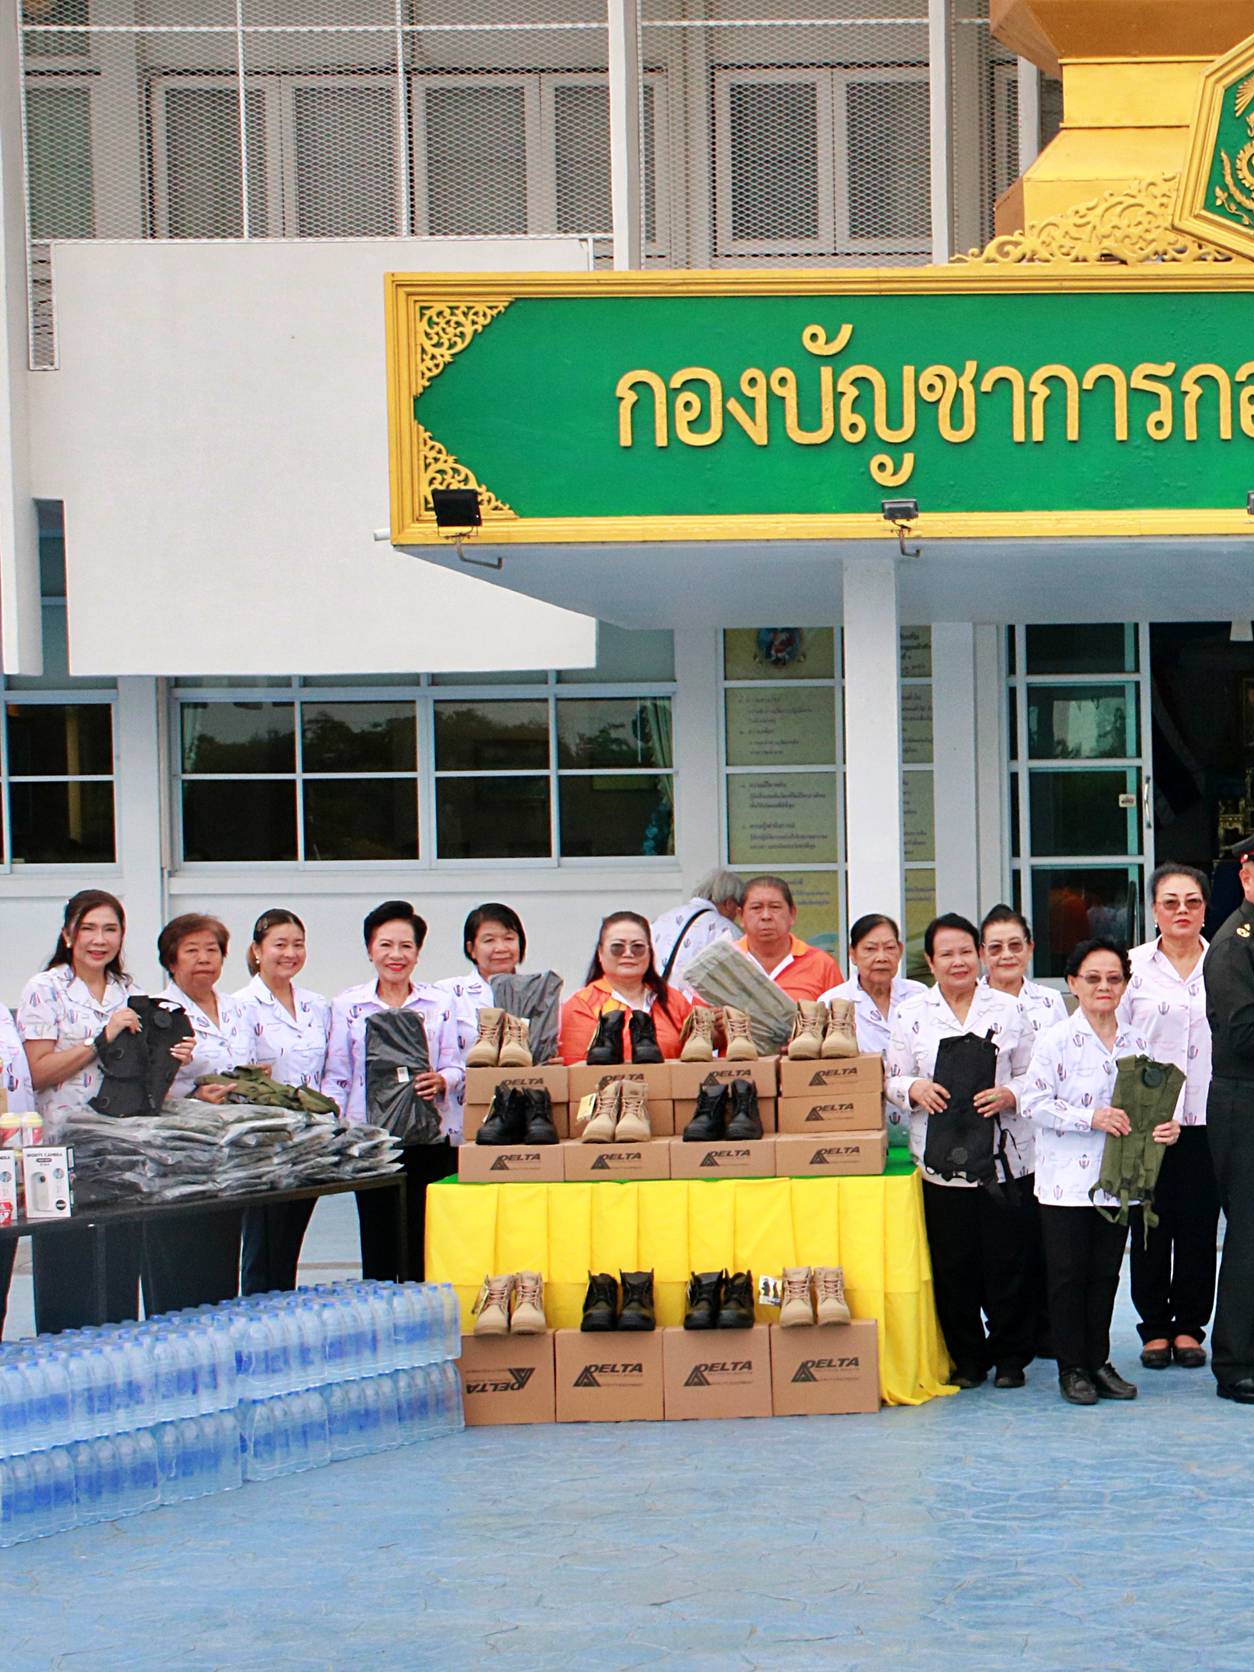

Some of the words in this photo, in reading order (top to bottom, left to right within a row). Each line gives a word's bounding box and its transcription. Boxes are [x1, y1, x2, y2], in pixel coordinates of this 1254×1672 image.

[711, 1068, 751, 1077] DELTA
[817, 1067, 858, 1077] DELTA
[501, 1077, 544, 1086] DELTA
[815, 1103, 855, 1112] DELTA
[709, 1149, 751, 1158] DELTA
[819, 1146, 860, 1155] DELTA
[500, 1153, 541, 1161] DELTA
[601, 1152, 642, 1161] DELTA
[699, 1360, 752, 1372] DELTA
[806, 1357, 859, 1369] DELTA
[588, 1363, 643, 1374] DELTA
[466, 1382, 522, 1394] DELTA
